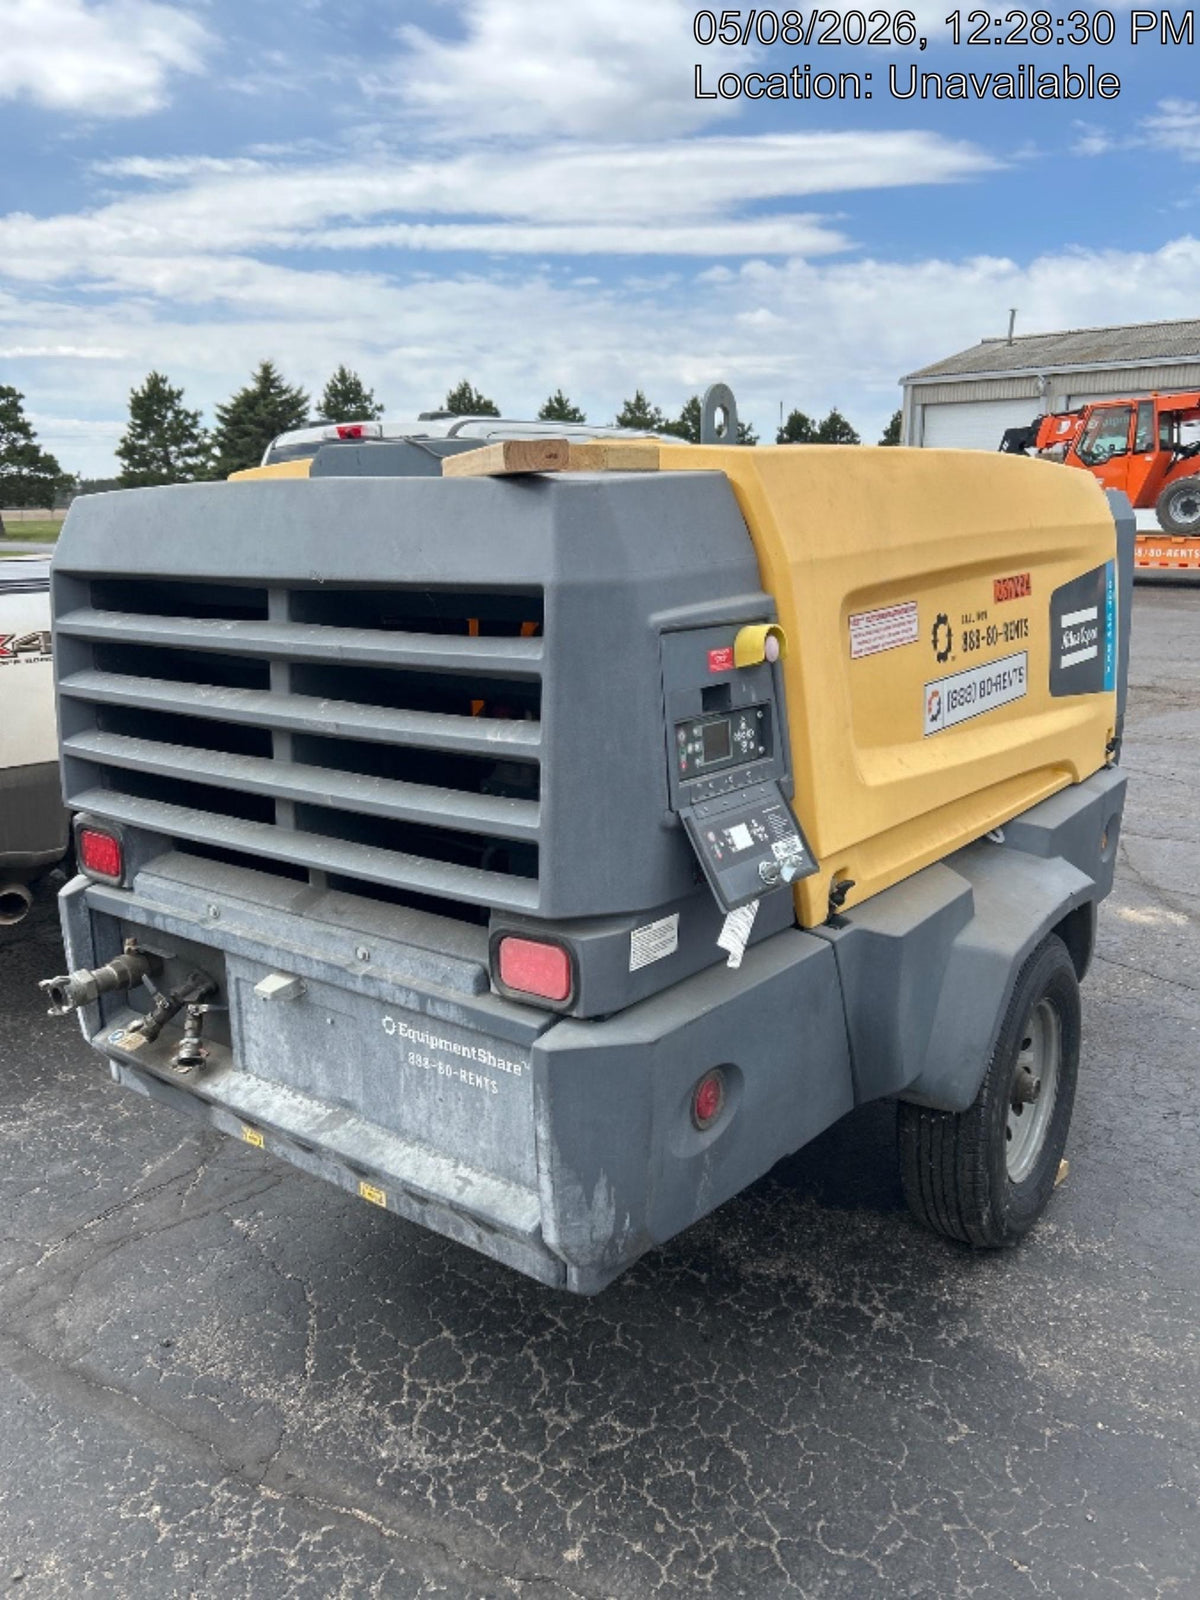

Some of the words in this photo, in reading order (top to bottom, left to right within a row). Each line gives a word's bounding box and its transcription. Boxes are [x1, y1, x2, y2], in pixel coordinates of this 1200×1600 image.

[947, 681, 977, 713] (888)
[979, 666, 1025, 699] 80-RENTS
[398, 1021, 523, 1077] EquipmentShare
[408, 1051, 499, 1095] 888-80-RENTS
